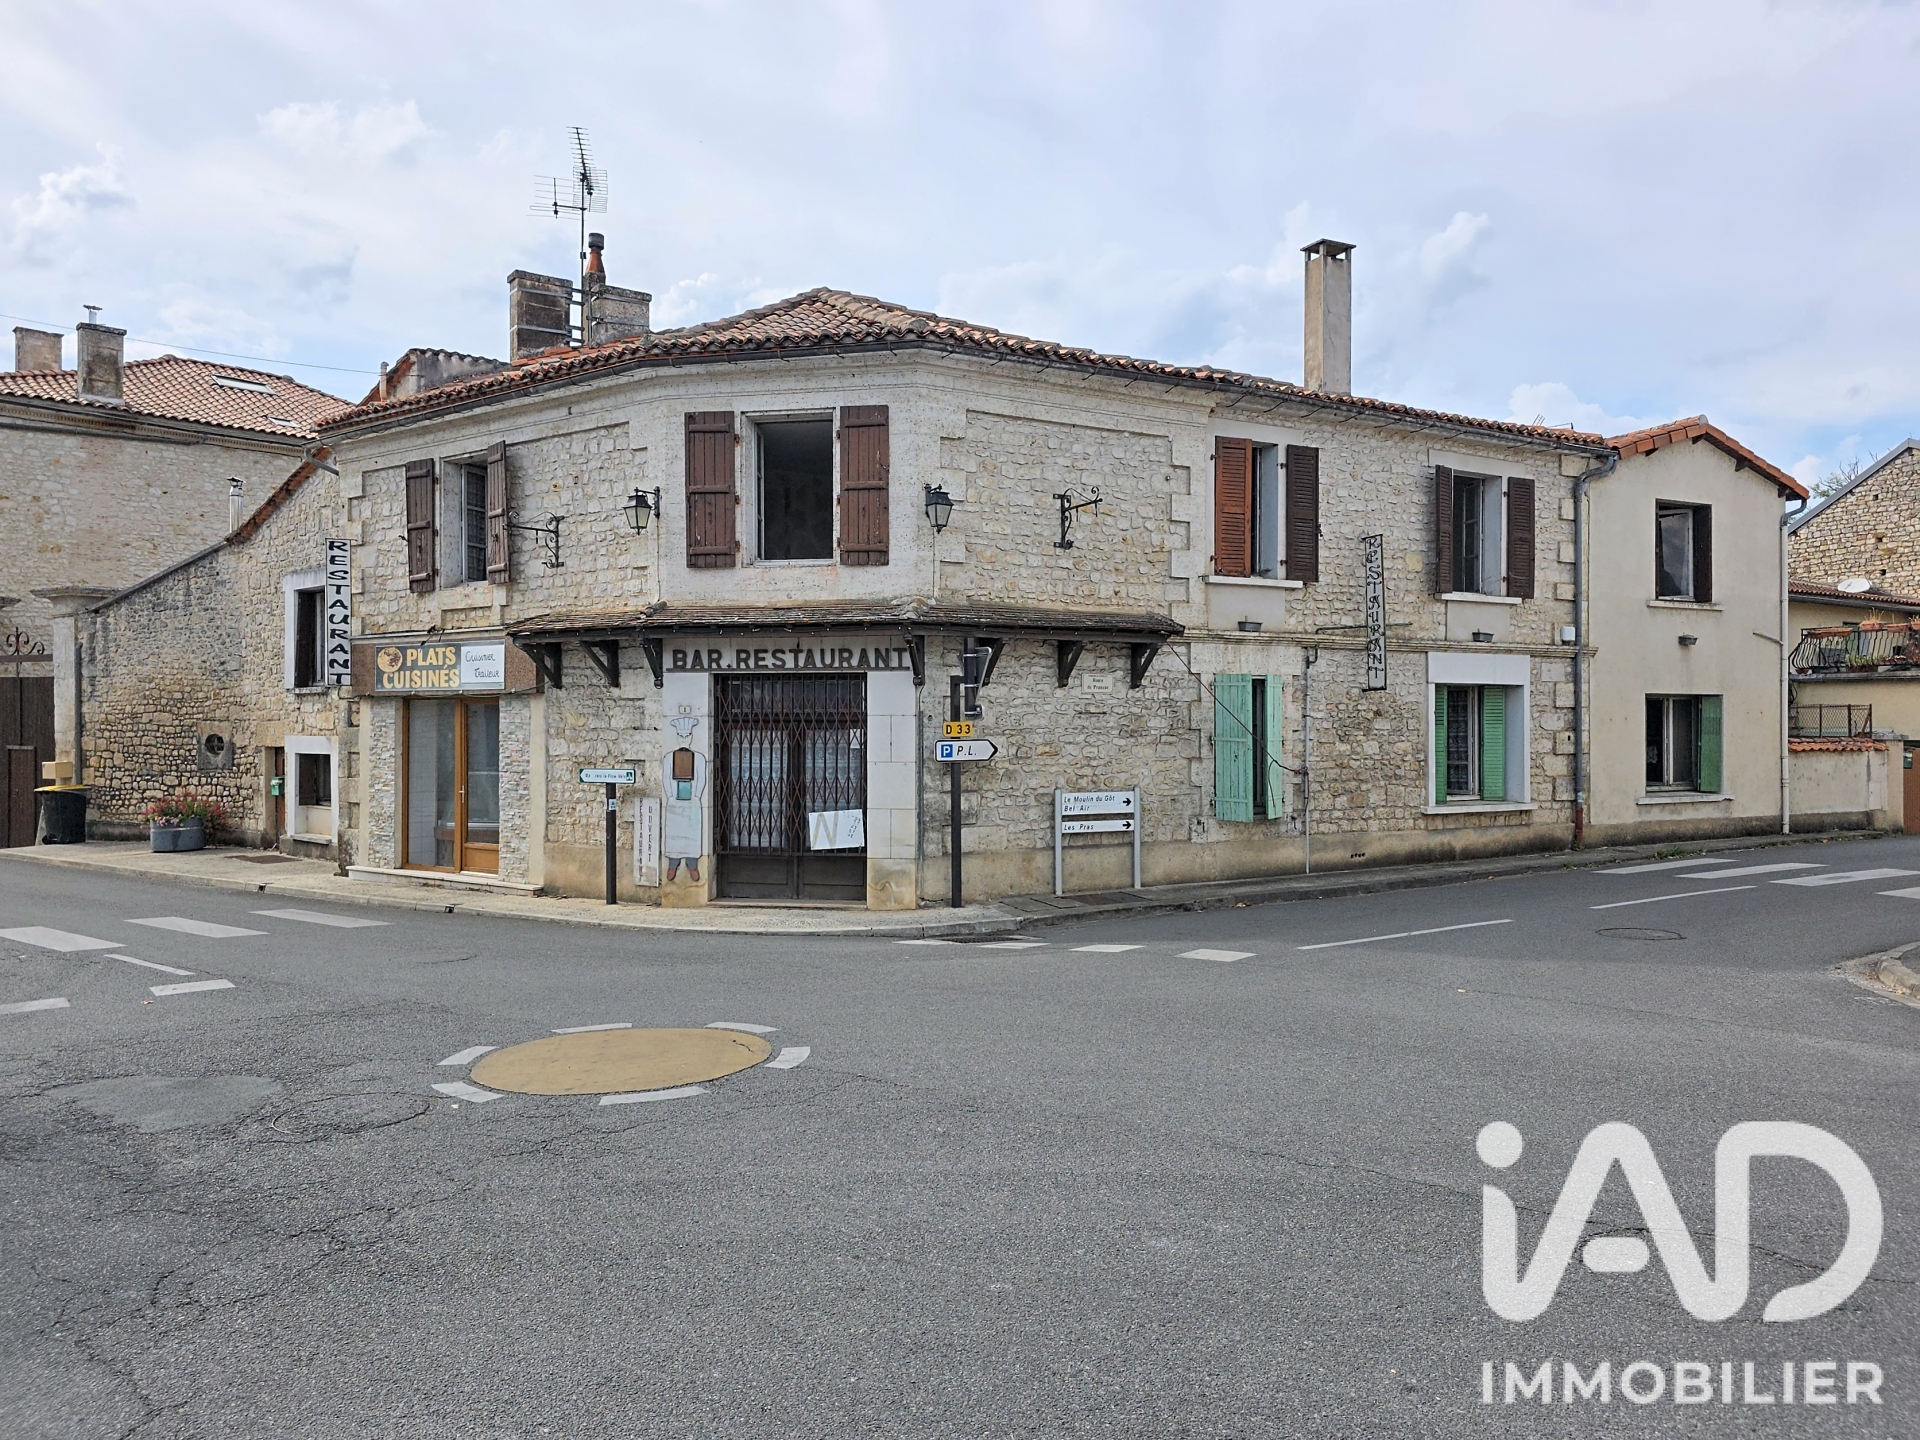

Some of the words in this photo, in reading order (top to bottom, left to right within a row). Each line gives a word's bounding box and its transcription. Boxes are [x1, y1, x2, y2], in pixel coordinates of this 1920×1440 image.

[327, 540, 351, 685] RESTAURANT
[1366, 536, 1384, 679] RESTAURANT
[406, 646, 457, 667] PLATS
[382, 664, 460, 689] CUISINÉS
[945, 724, 953, 735] D
[956, 724, 971, 735] 33
[956, 745, 977, 756] P.L.
[1073, 795, 1094, 803] Moulin
[1079, 823, 1094, 831] Pras
